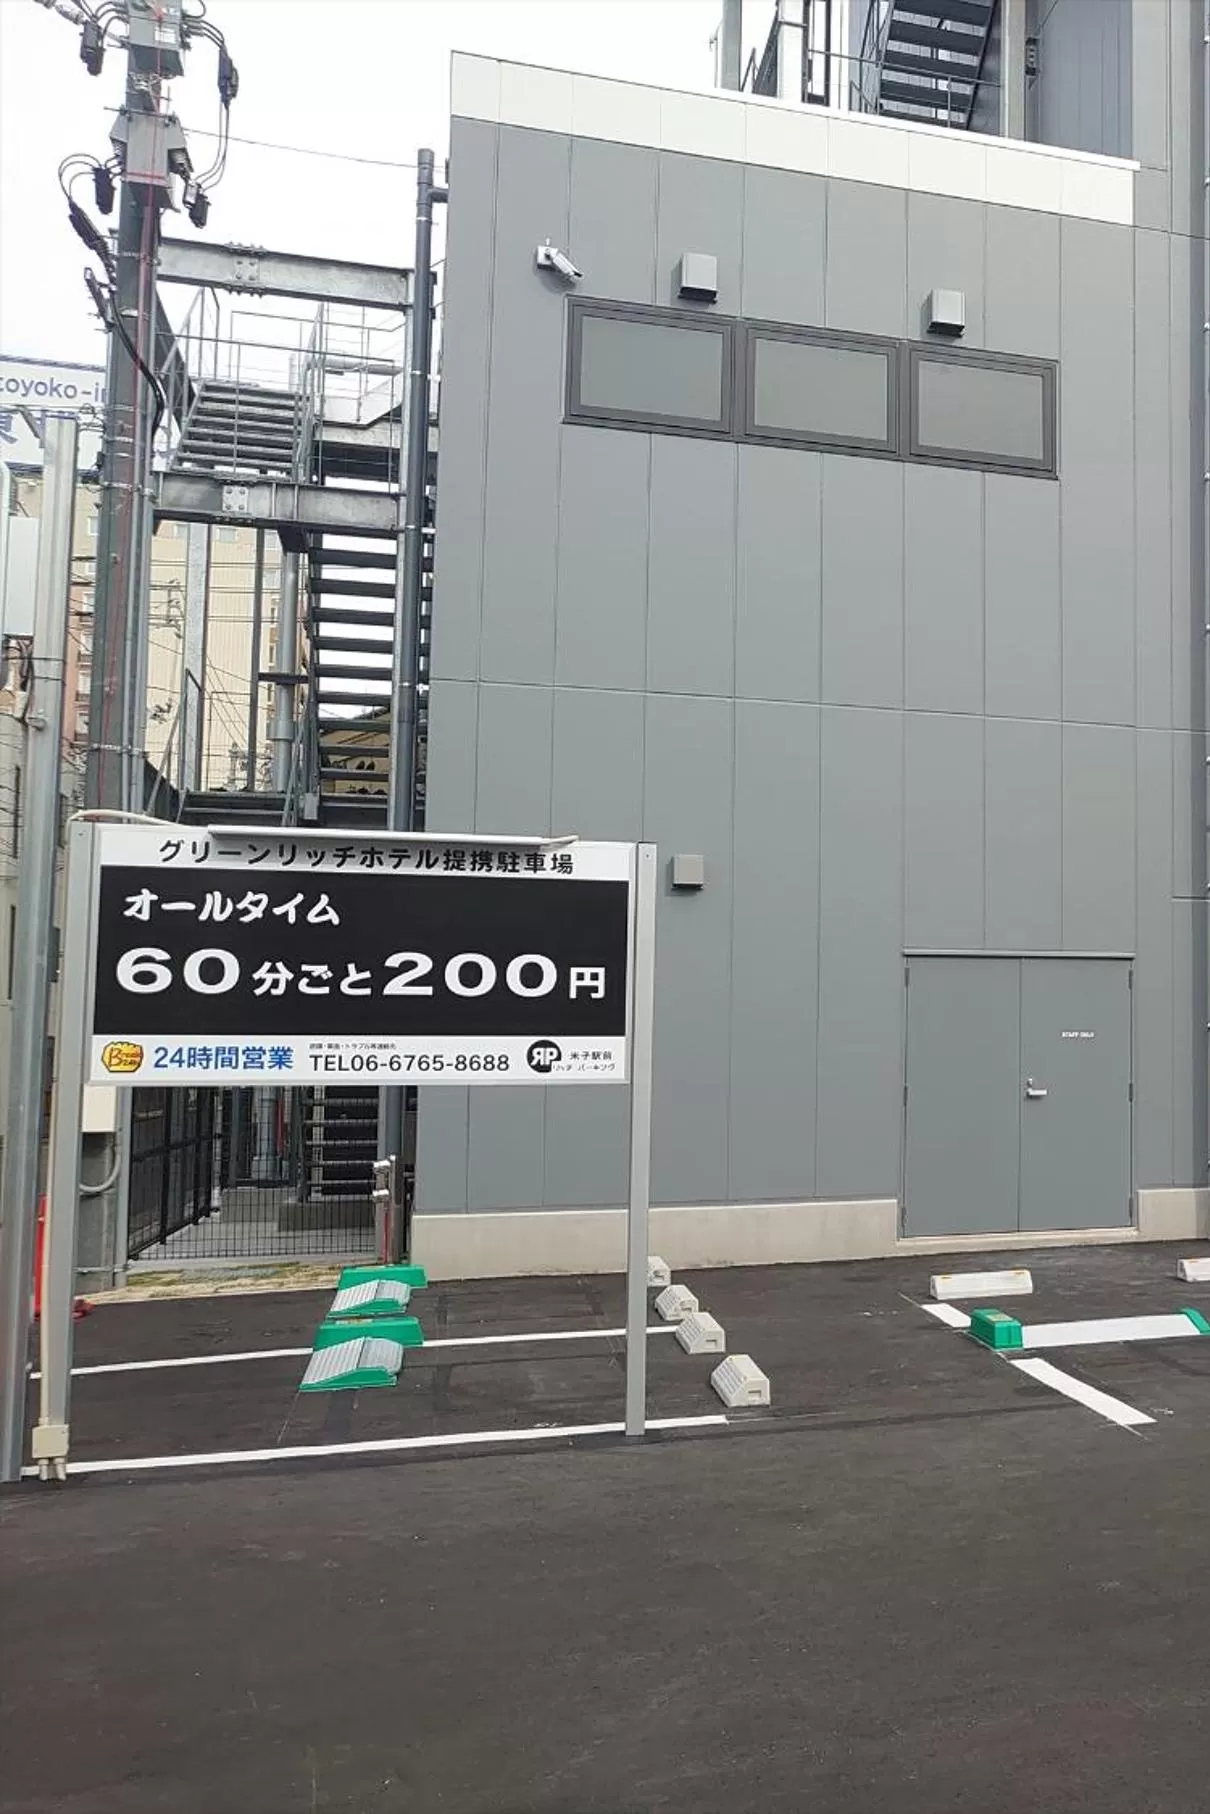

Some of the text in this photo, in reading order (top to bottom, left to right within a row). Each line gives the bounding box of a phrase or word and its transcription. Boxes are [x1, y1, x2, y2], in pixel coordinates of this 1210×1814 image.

[159, 838, 574, 875] グリーンリッチホテル提携駐車場
[122, 887, 342, 926] オールタイム
[153, 1045, 295, 1070] 24時間営業
[309, 1054, 510, 1072] TEL06-6765-8688
